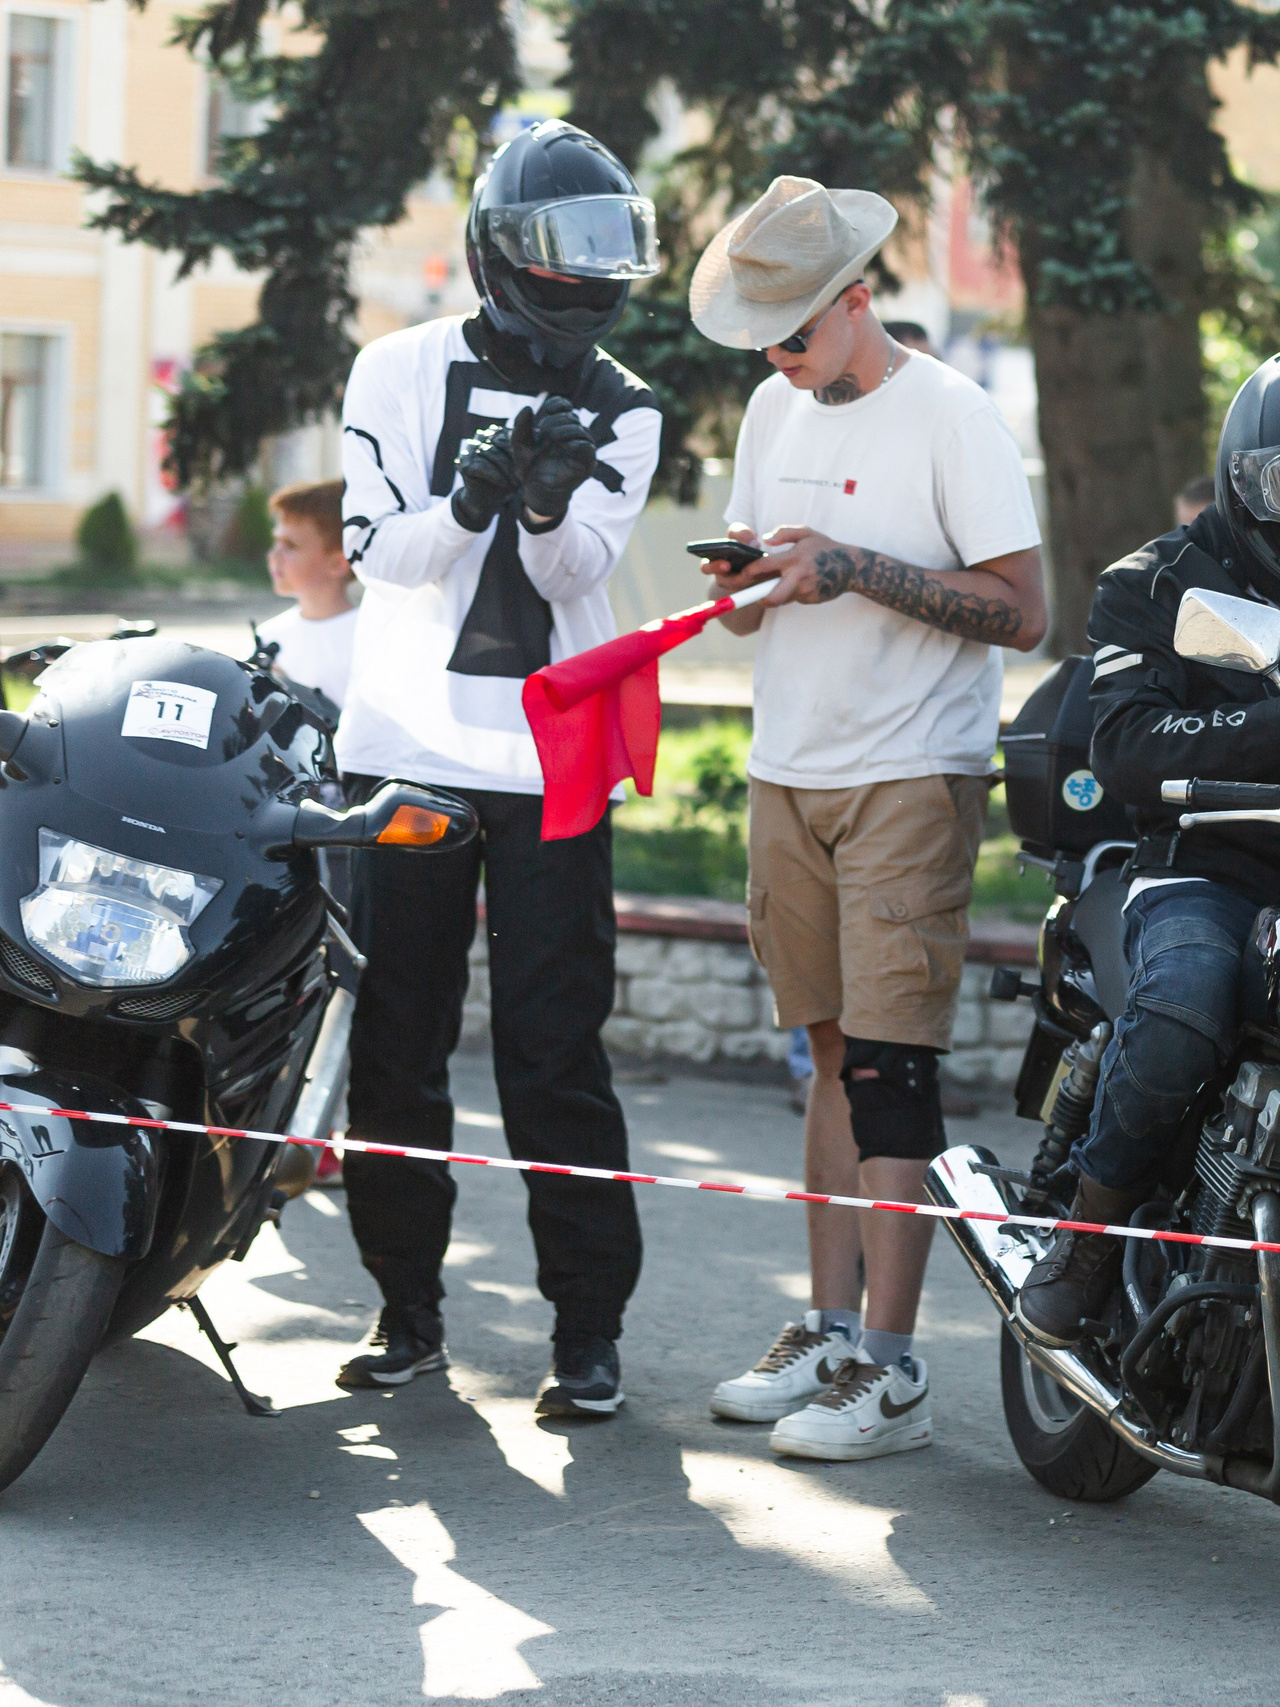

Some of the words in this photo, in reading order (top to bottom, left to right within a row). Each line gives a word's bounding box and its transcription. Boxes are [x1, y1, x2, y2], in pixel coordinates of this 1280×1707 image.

[157, 701, 184, 721] 11
[1151, 709, 1246, 735] MOEQ
[121, 815, 166, 834] HONDA
